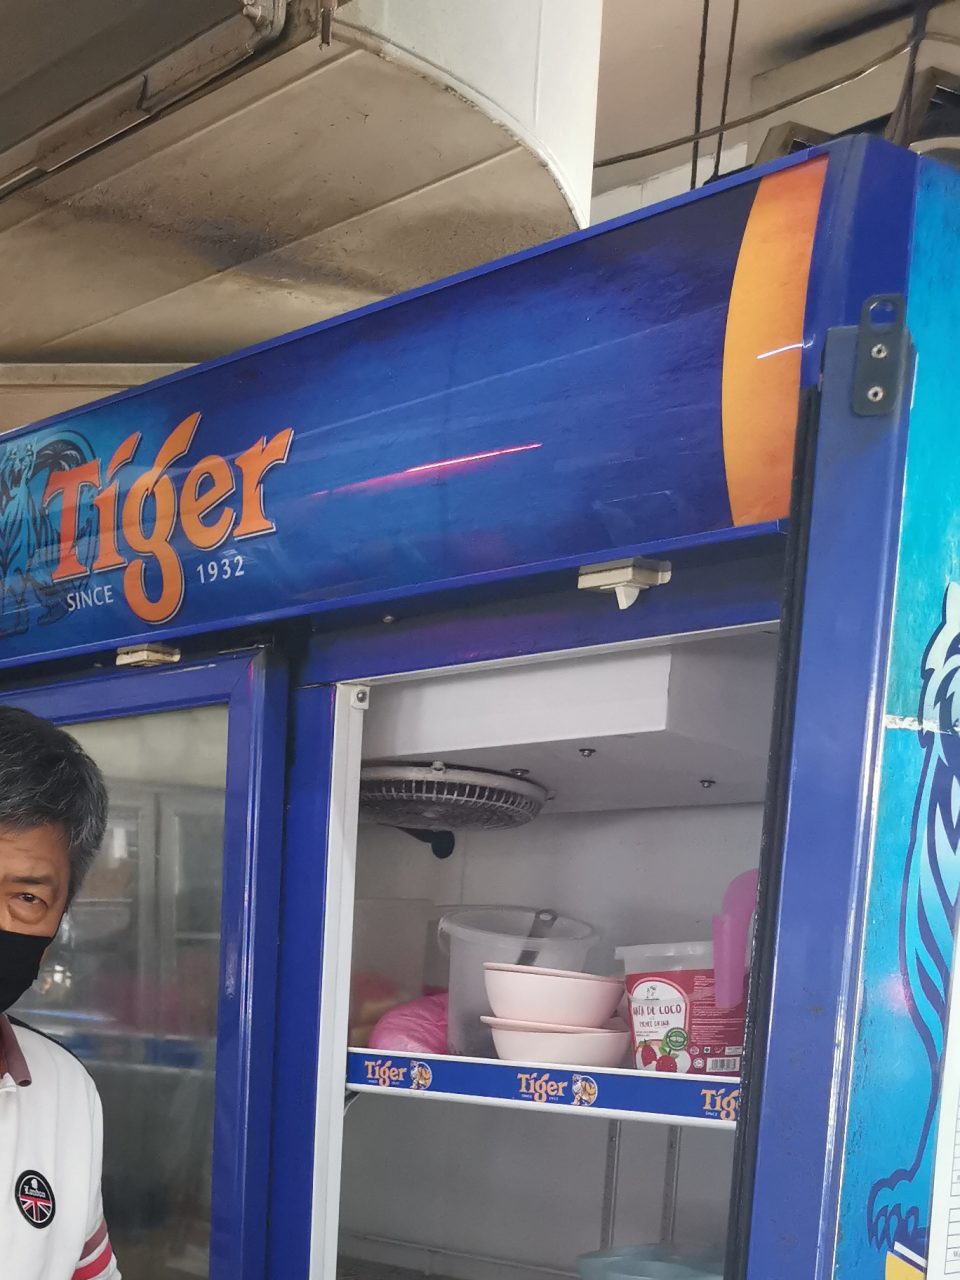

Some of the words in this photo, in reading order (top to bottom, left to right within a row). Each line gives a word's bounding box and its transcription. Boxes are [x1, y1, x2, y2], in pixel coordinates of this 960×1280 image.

[42, 411, 294, 625] Tiger
[66, 585, 115, 612] SINCE
[196, 556, 245, 584] 1932
[364, 1060, 407, 1087] Tiger
[517, 1072, 568, 1104] Tiger
[700, 1088, 740, 1121] Tig
